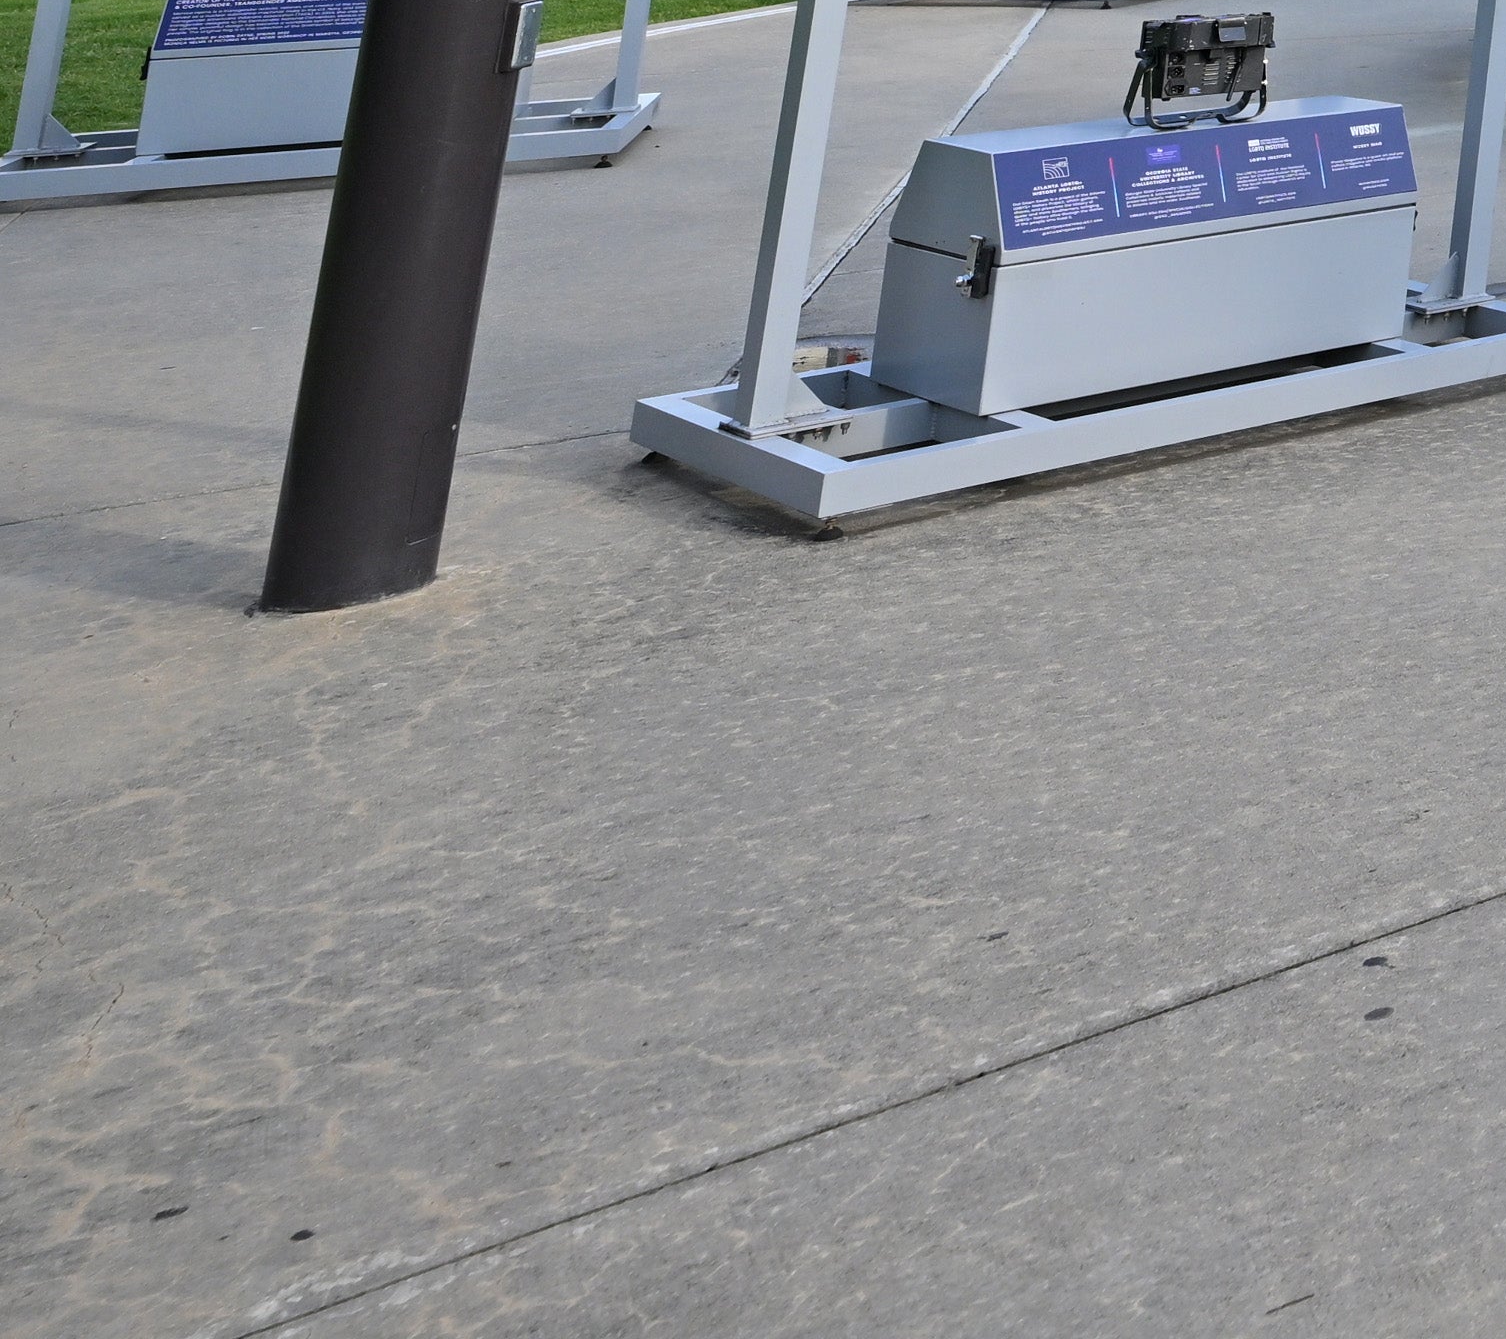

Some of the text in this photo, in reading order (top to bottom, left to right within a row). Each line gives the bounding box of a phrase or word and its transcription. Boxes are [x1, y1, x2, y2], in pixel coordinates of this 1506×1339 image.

[1350, 123, 1379, 136] WUSSY
[1132, 179, 1169, 187] COLLECTIONS
[1177, 174, 1204, 182] ARCHIVES
[1058, 185, 1084, 193] PROJECT
